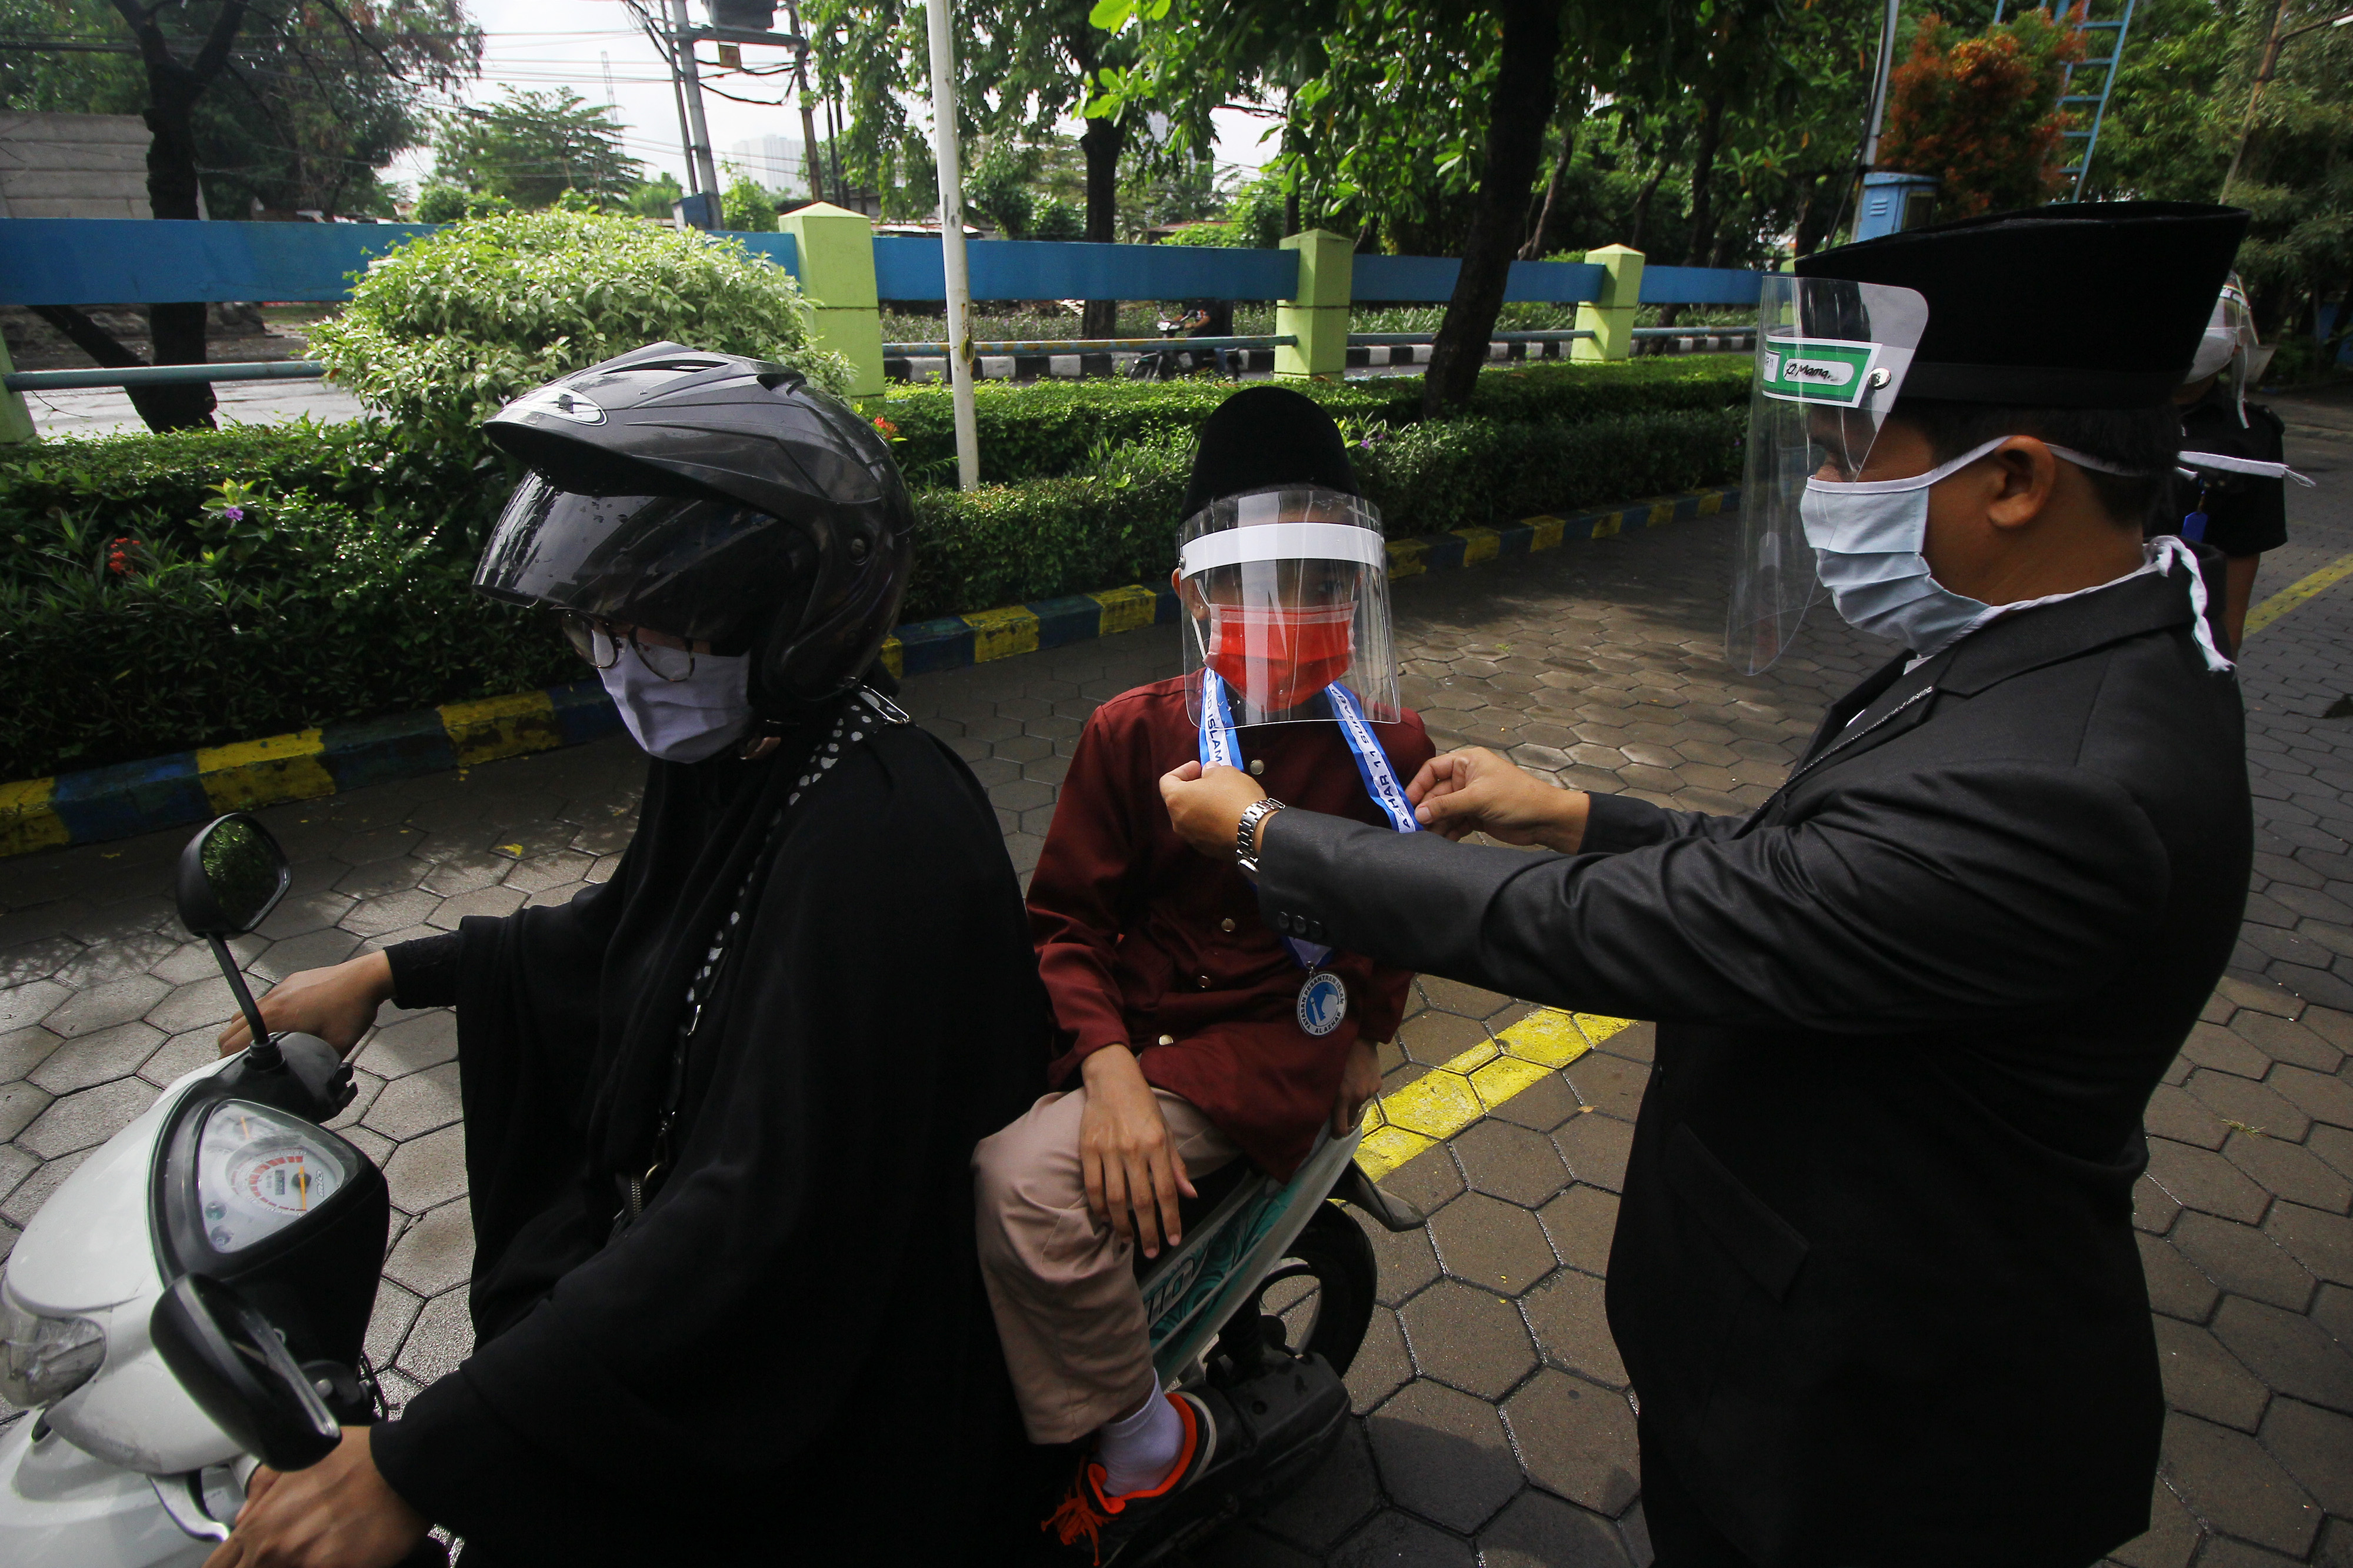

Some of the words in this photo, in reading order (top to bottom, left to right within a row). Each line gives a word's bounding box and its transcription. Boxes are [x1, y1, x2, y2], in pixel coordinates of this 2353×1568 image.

[1331, 688, 1369, 744] SURABA
[1207, 713, 1222, 762] ISLAM
[1379, 775, 1411, 829] AZHAR
[1304, 975, 1337, 995] PESANTREN
[1336, 982, 1344, 1005] ISLAM
[1301, 997, 1311, 1029] YAYASAN
[1324, 1012, 1341, 1032] AZHAR
